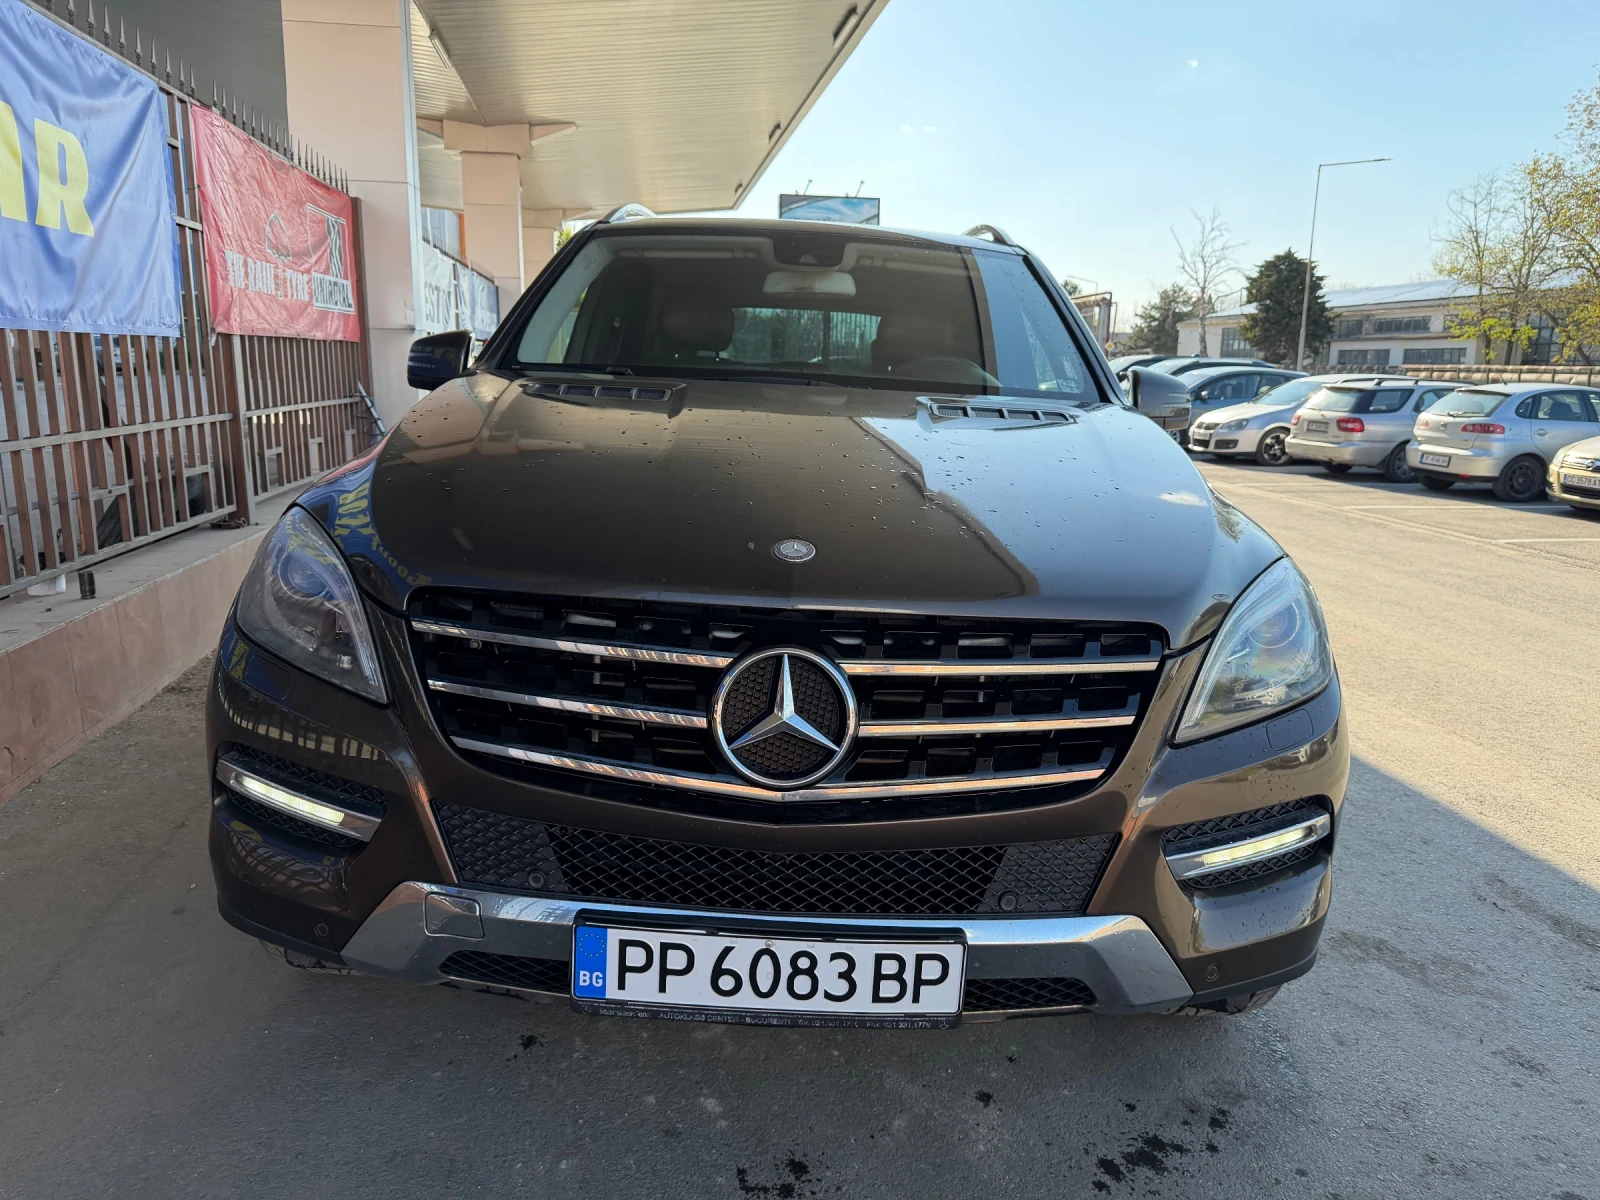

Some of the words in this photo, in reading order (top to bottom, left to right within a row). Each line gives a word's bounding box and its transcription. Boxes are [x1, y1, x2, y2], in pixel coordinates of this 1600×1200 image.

[579, 970, 603, 987] BG
[617, 938, 695, 993] PP
[710, 945, 857, 1002] 6083
[871, 952, 950, 1004] BP
